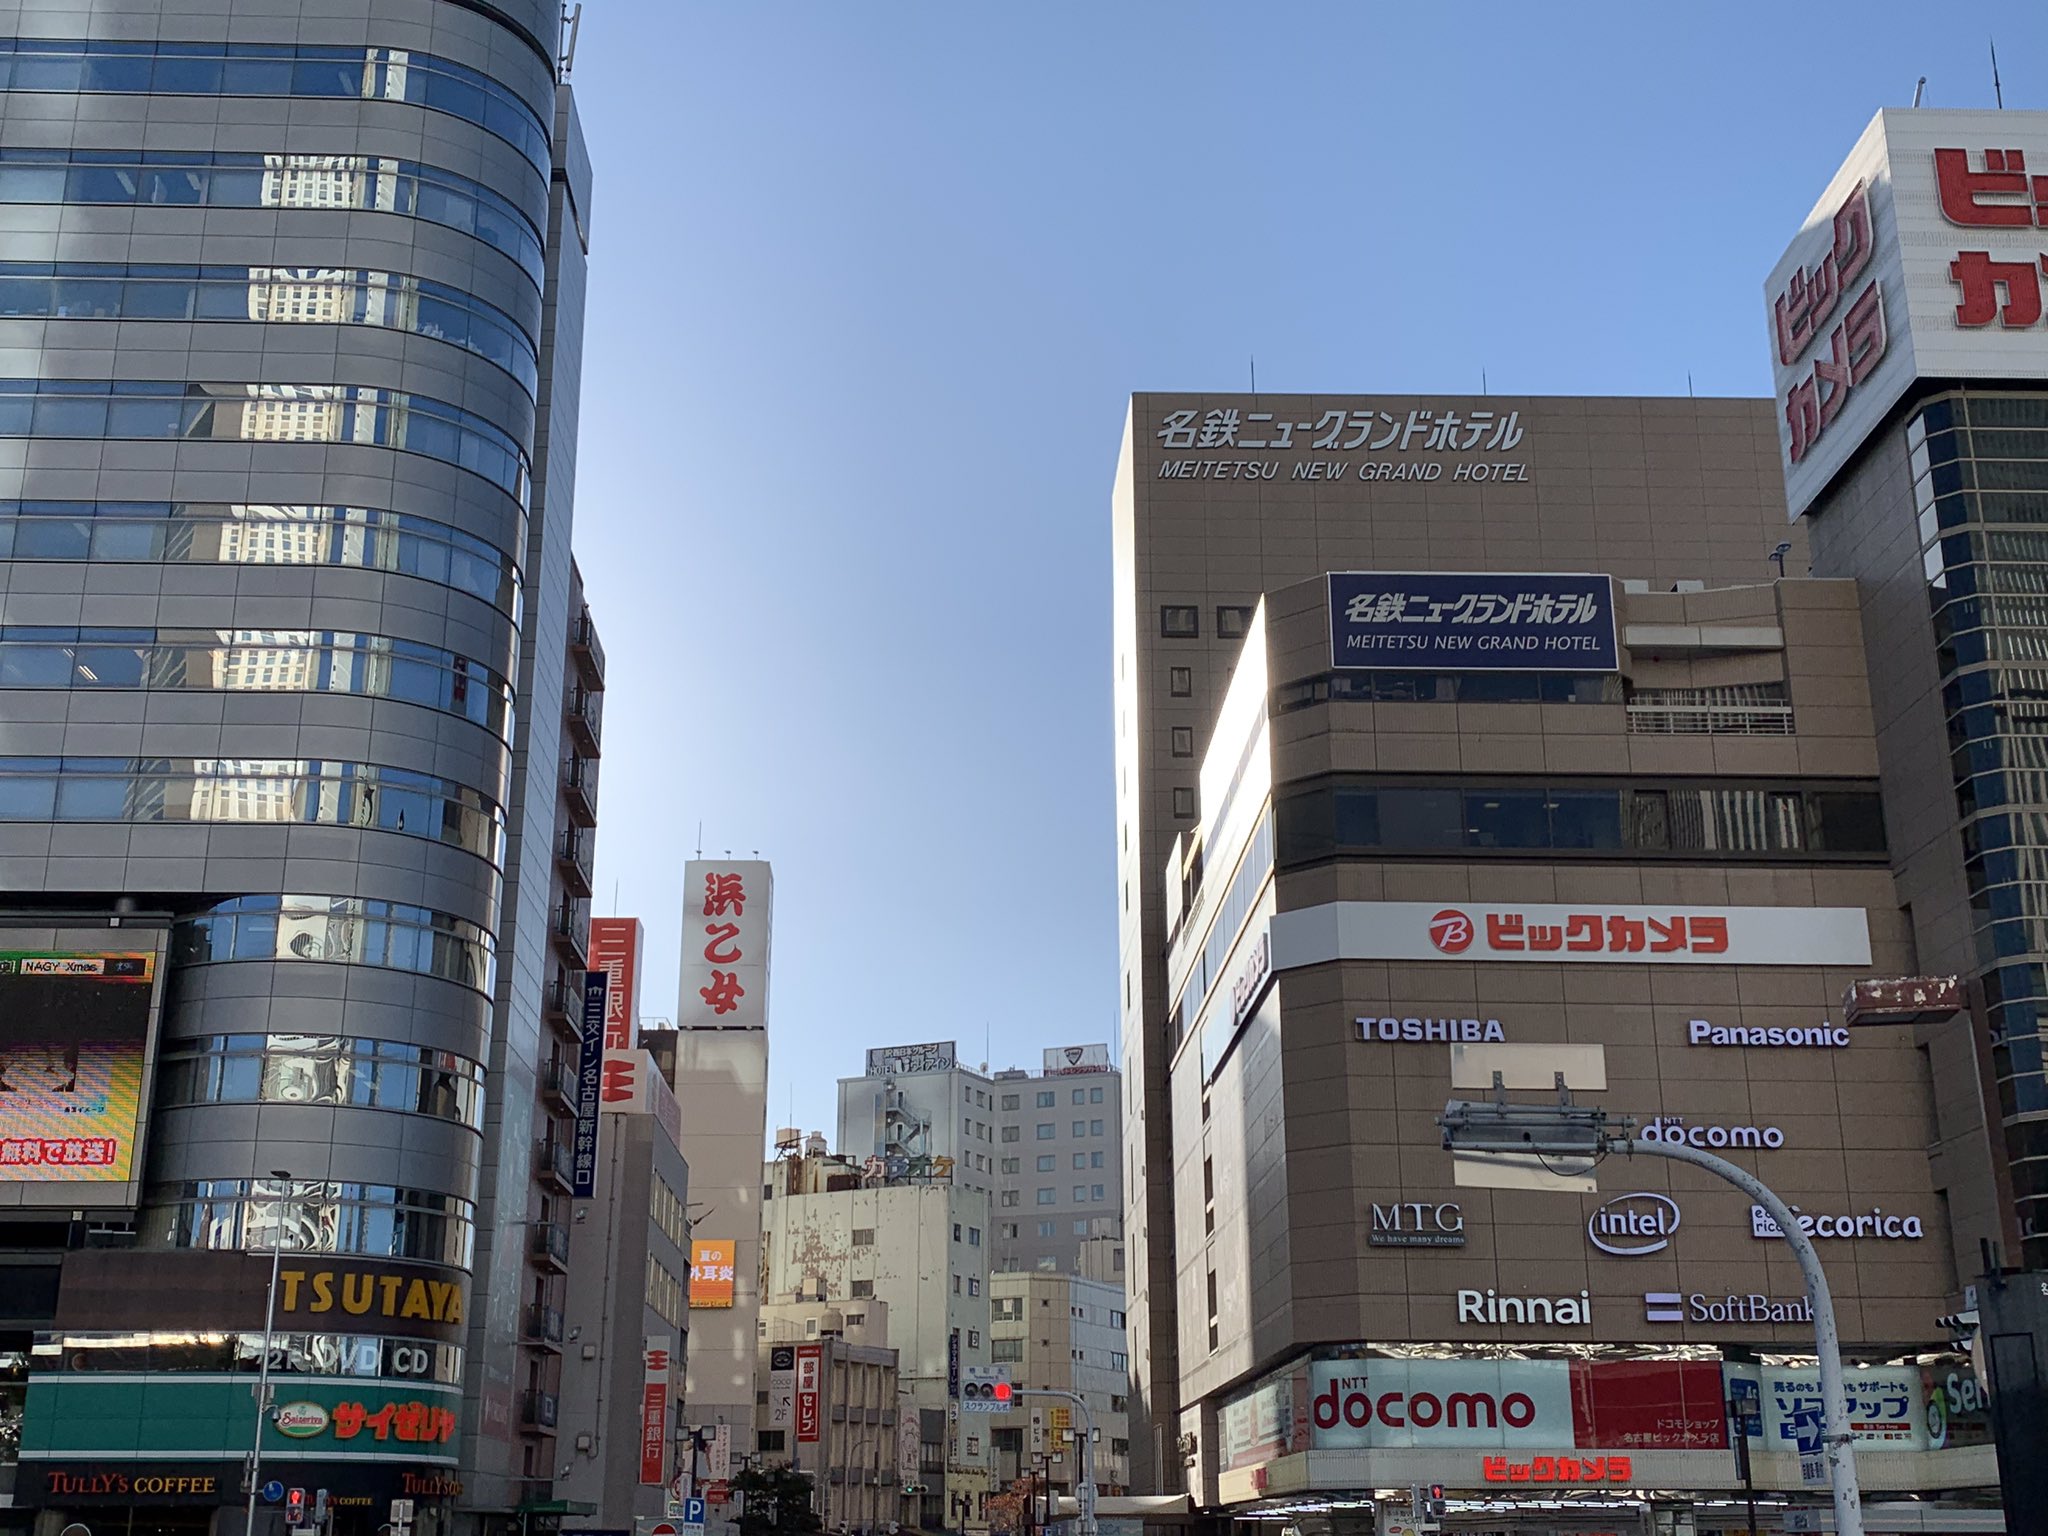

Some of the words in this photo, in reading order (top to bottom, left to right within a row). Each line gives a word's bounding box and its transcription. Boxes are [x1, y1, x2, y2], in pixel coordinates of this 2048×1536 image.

[1934, 147, 2048, 228] ビ
[1775, 176, 1874, 366] ビック
[1950, 250, 2048, 328] カ
[1786, 278, 1887, 464] カメラ
[1156, 408, 1524, 450] 名鉄ニューグランドホテル
[1158, 461, 1281, 480] MEITETSU
[1292, 462, 1349, 481] NEW
[1358, 462, 1442, 481] GRAND
[1453, 463, 1529, 482] HOTEL
[1345, 592, 1597, 624] 名鉄ニューグランドホテル
[1346, 635, 1428, 649] MEITETSU
[1434, 635, 1473, 649] NEW
[1477, 635, 1539, 650] GRAND
[1545, 636, 1600, 650] HOTEL
[699, 872, 747, 1015] 浜乙女
[1485, 913, 1729, 953] ビックカメラ
[66, 961, 99, 972] Xmas
[1356, 1017, 1506, 1042] TOSHIBA
[1689, 1019, 1850, 1047] Panasonic
[575, 1003, 601, 1185] 三交イン名古屋新幹線口
[1641, 1117, 1785, 1148] docomo
[1663, 1117, 1684, 1125] NTT
[861, 1154, 956, 1179] カラオケ
[1372, 1202, 1464, 1232] MTG
[1600, 1206, 1664, 1236] intel
[1796, 1206, 1924, 1239] ecorica
[1371, 1235, 1385, 1243] We
[1387, 1235, 1407, 1243] have
[1409, 1236, 1432, 1246] many
[1434, 1233, 1465, 1244] dreams
[280, 1270, 464, 1325] TSUTAYA
[1457, 1288, 1592, 1324] Rinnai
[1690, 1293, 1815, 1322] SoftBank
[318, 1345, 379, 1371] DVD
[393, 1347, 429, 1374] CD
[1341, 1376, 1369, 1389] NTT
[1858, 1381, 1908, 1393] サポートも
[775, 1408, 787, 1421] 2F
[965, 1402, 1009, 1412] スクランブル式
[1313, 1378, 1536, 1429] docomo
[332, 1401, 457, 1443] サイゼリヤ
[645, 1393, 662, 1459] 三重銀行
[1656, 1419, 1719, 1430] ドコモショップ
[1623, 1432, 1720, 1444] 名古屋ビックカメラ店
[1482, 1456, 1633, 1482] ビックカメラ
[134, 1476, 216, 1494] COFFEE
[340, 1497, 373, 1505] COFFEE
[688, 1501, 702, 1521] P
